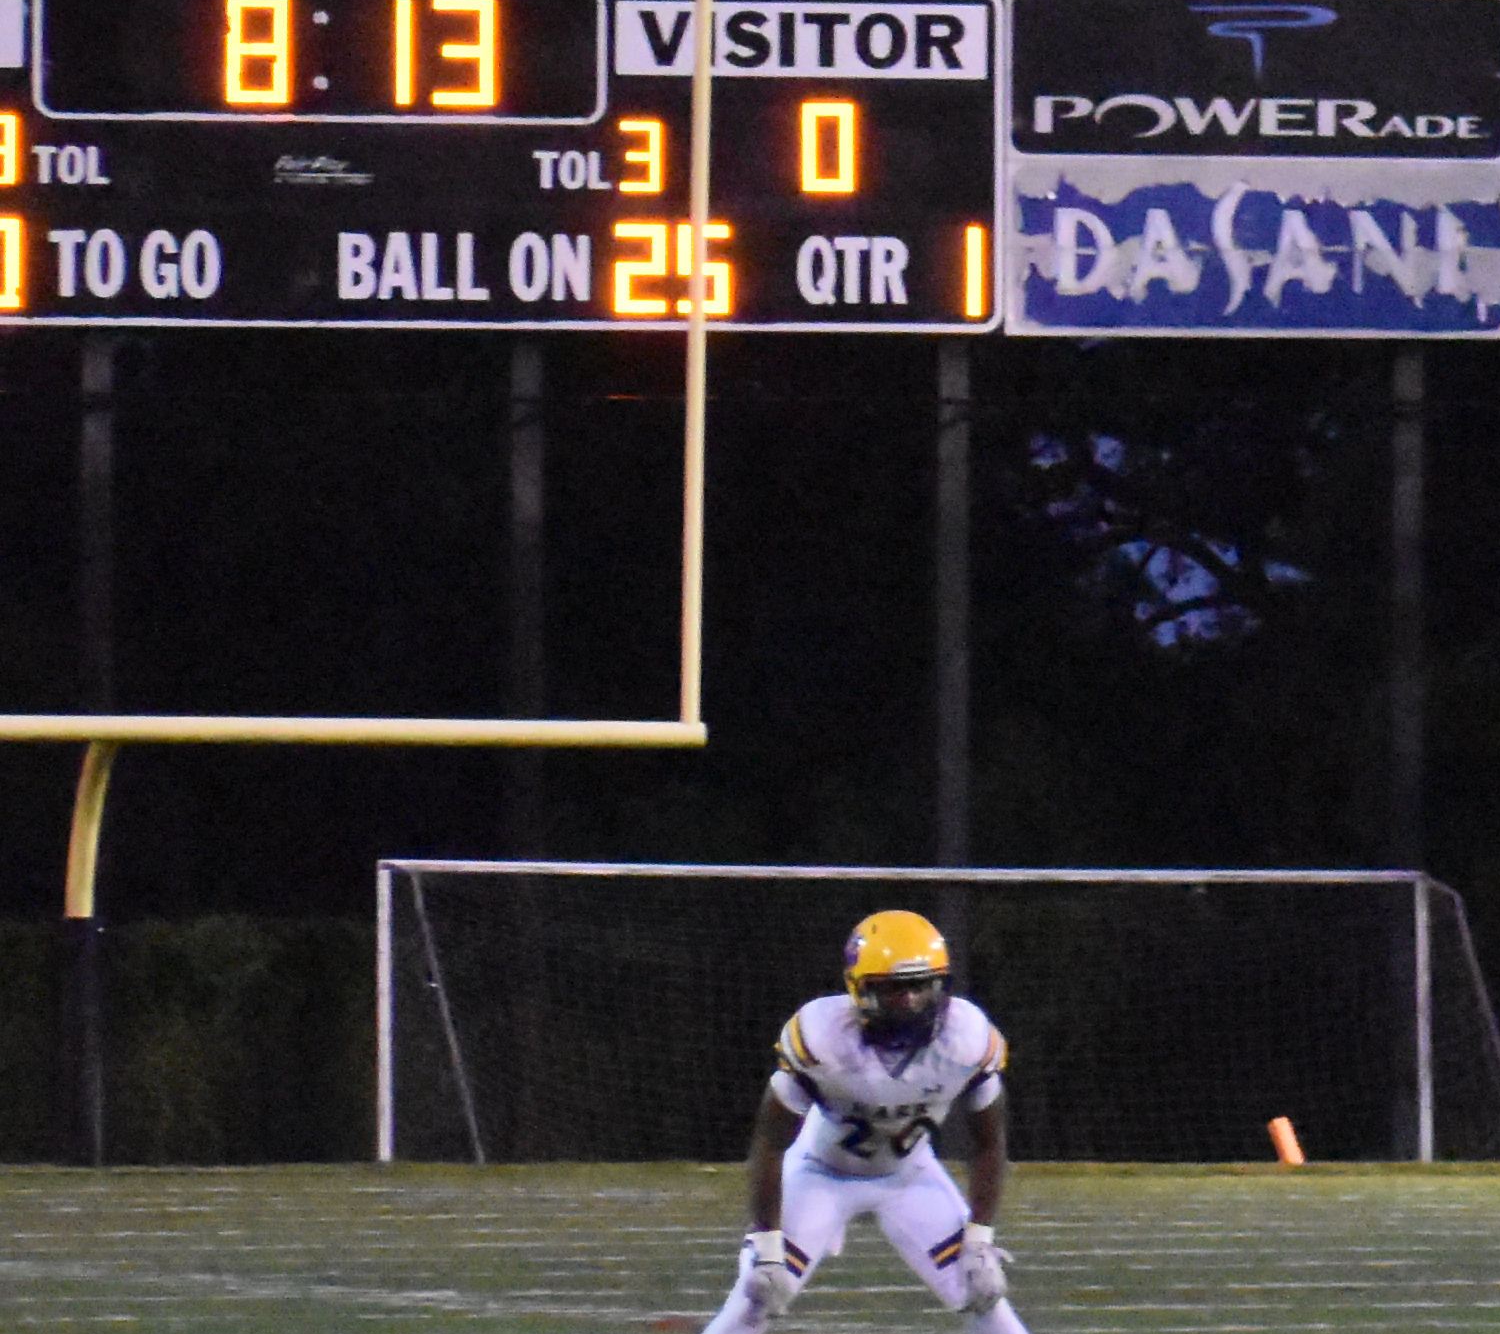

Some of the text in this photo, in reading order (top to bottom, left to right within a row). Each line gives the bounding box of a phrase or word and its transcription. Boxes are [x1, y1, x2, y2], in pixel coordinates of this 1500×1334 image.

[637, 9, 967, 70] VSITOR
[32, 145, 112, 186] TOL
[533, 120, 662, 193] TOL 3
[801, 102, 855, 194] 0
[48, 229, 125, 299] TO
[139, 229, 223, 299] GO
[337, 222, 731, 315] BALL ON 25
[796, 225, 984, 317] QTR 1
